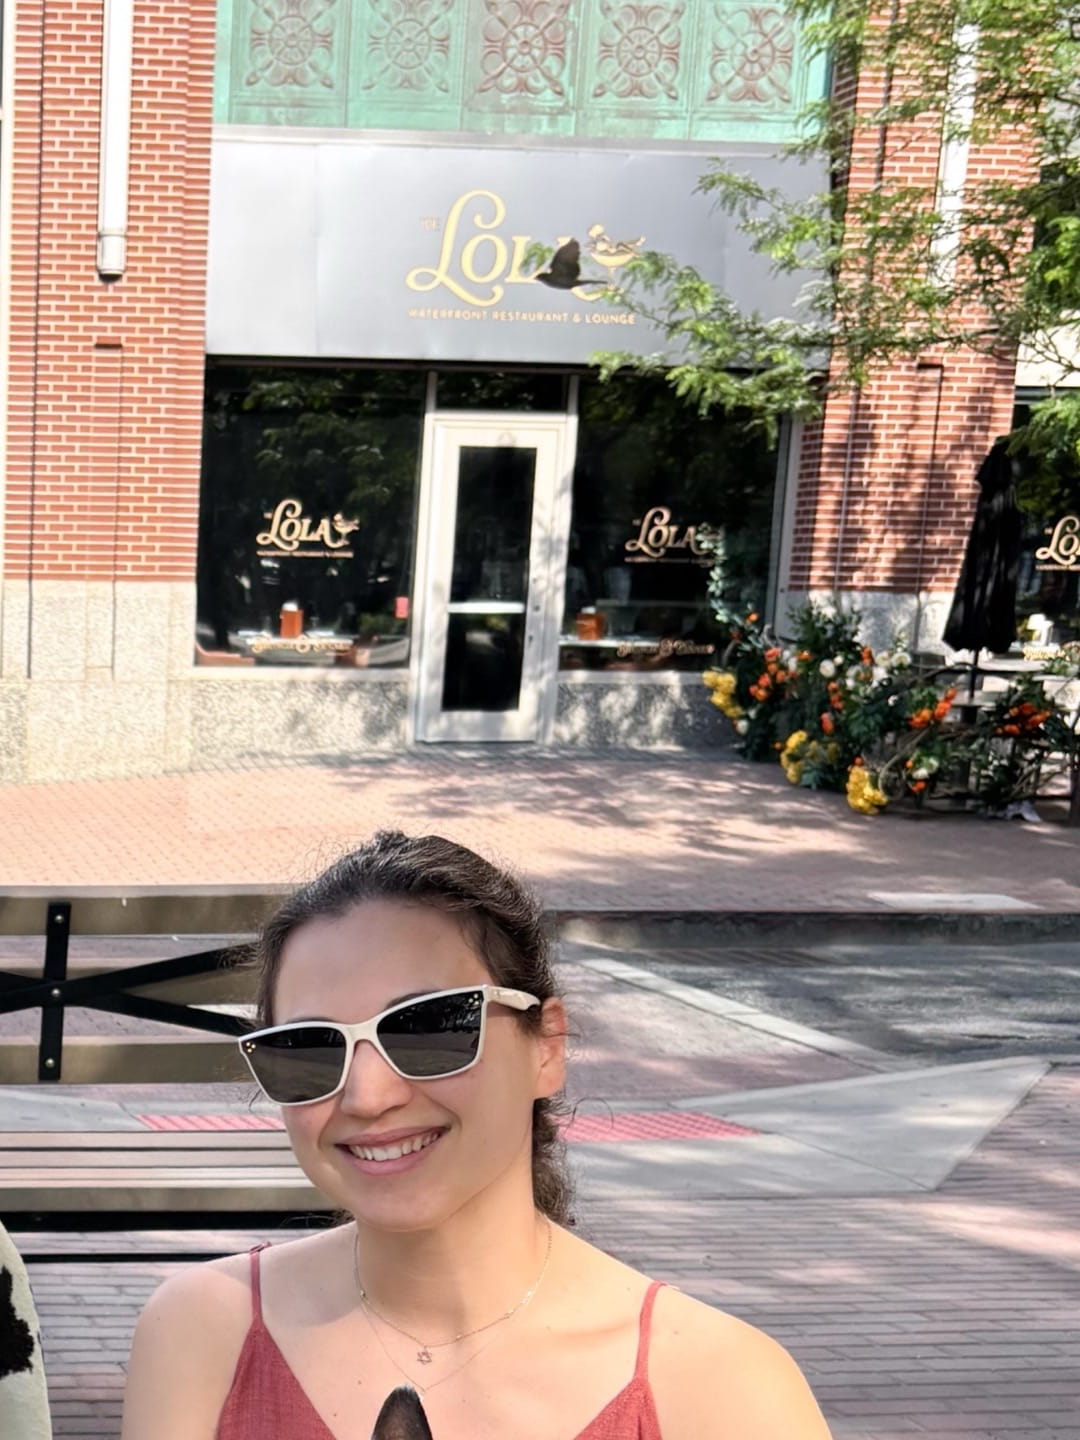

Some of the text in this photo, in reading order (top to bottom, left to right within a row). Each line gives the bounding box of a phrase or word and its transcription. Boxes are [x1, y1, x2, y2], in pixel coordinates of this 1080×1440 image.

[408, 309, 636, 325] WATERFRONT RESTAURANT & LOUNGE
